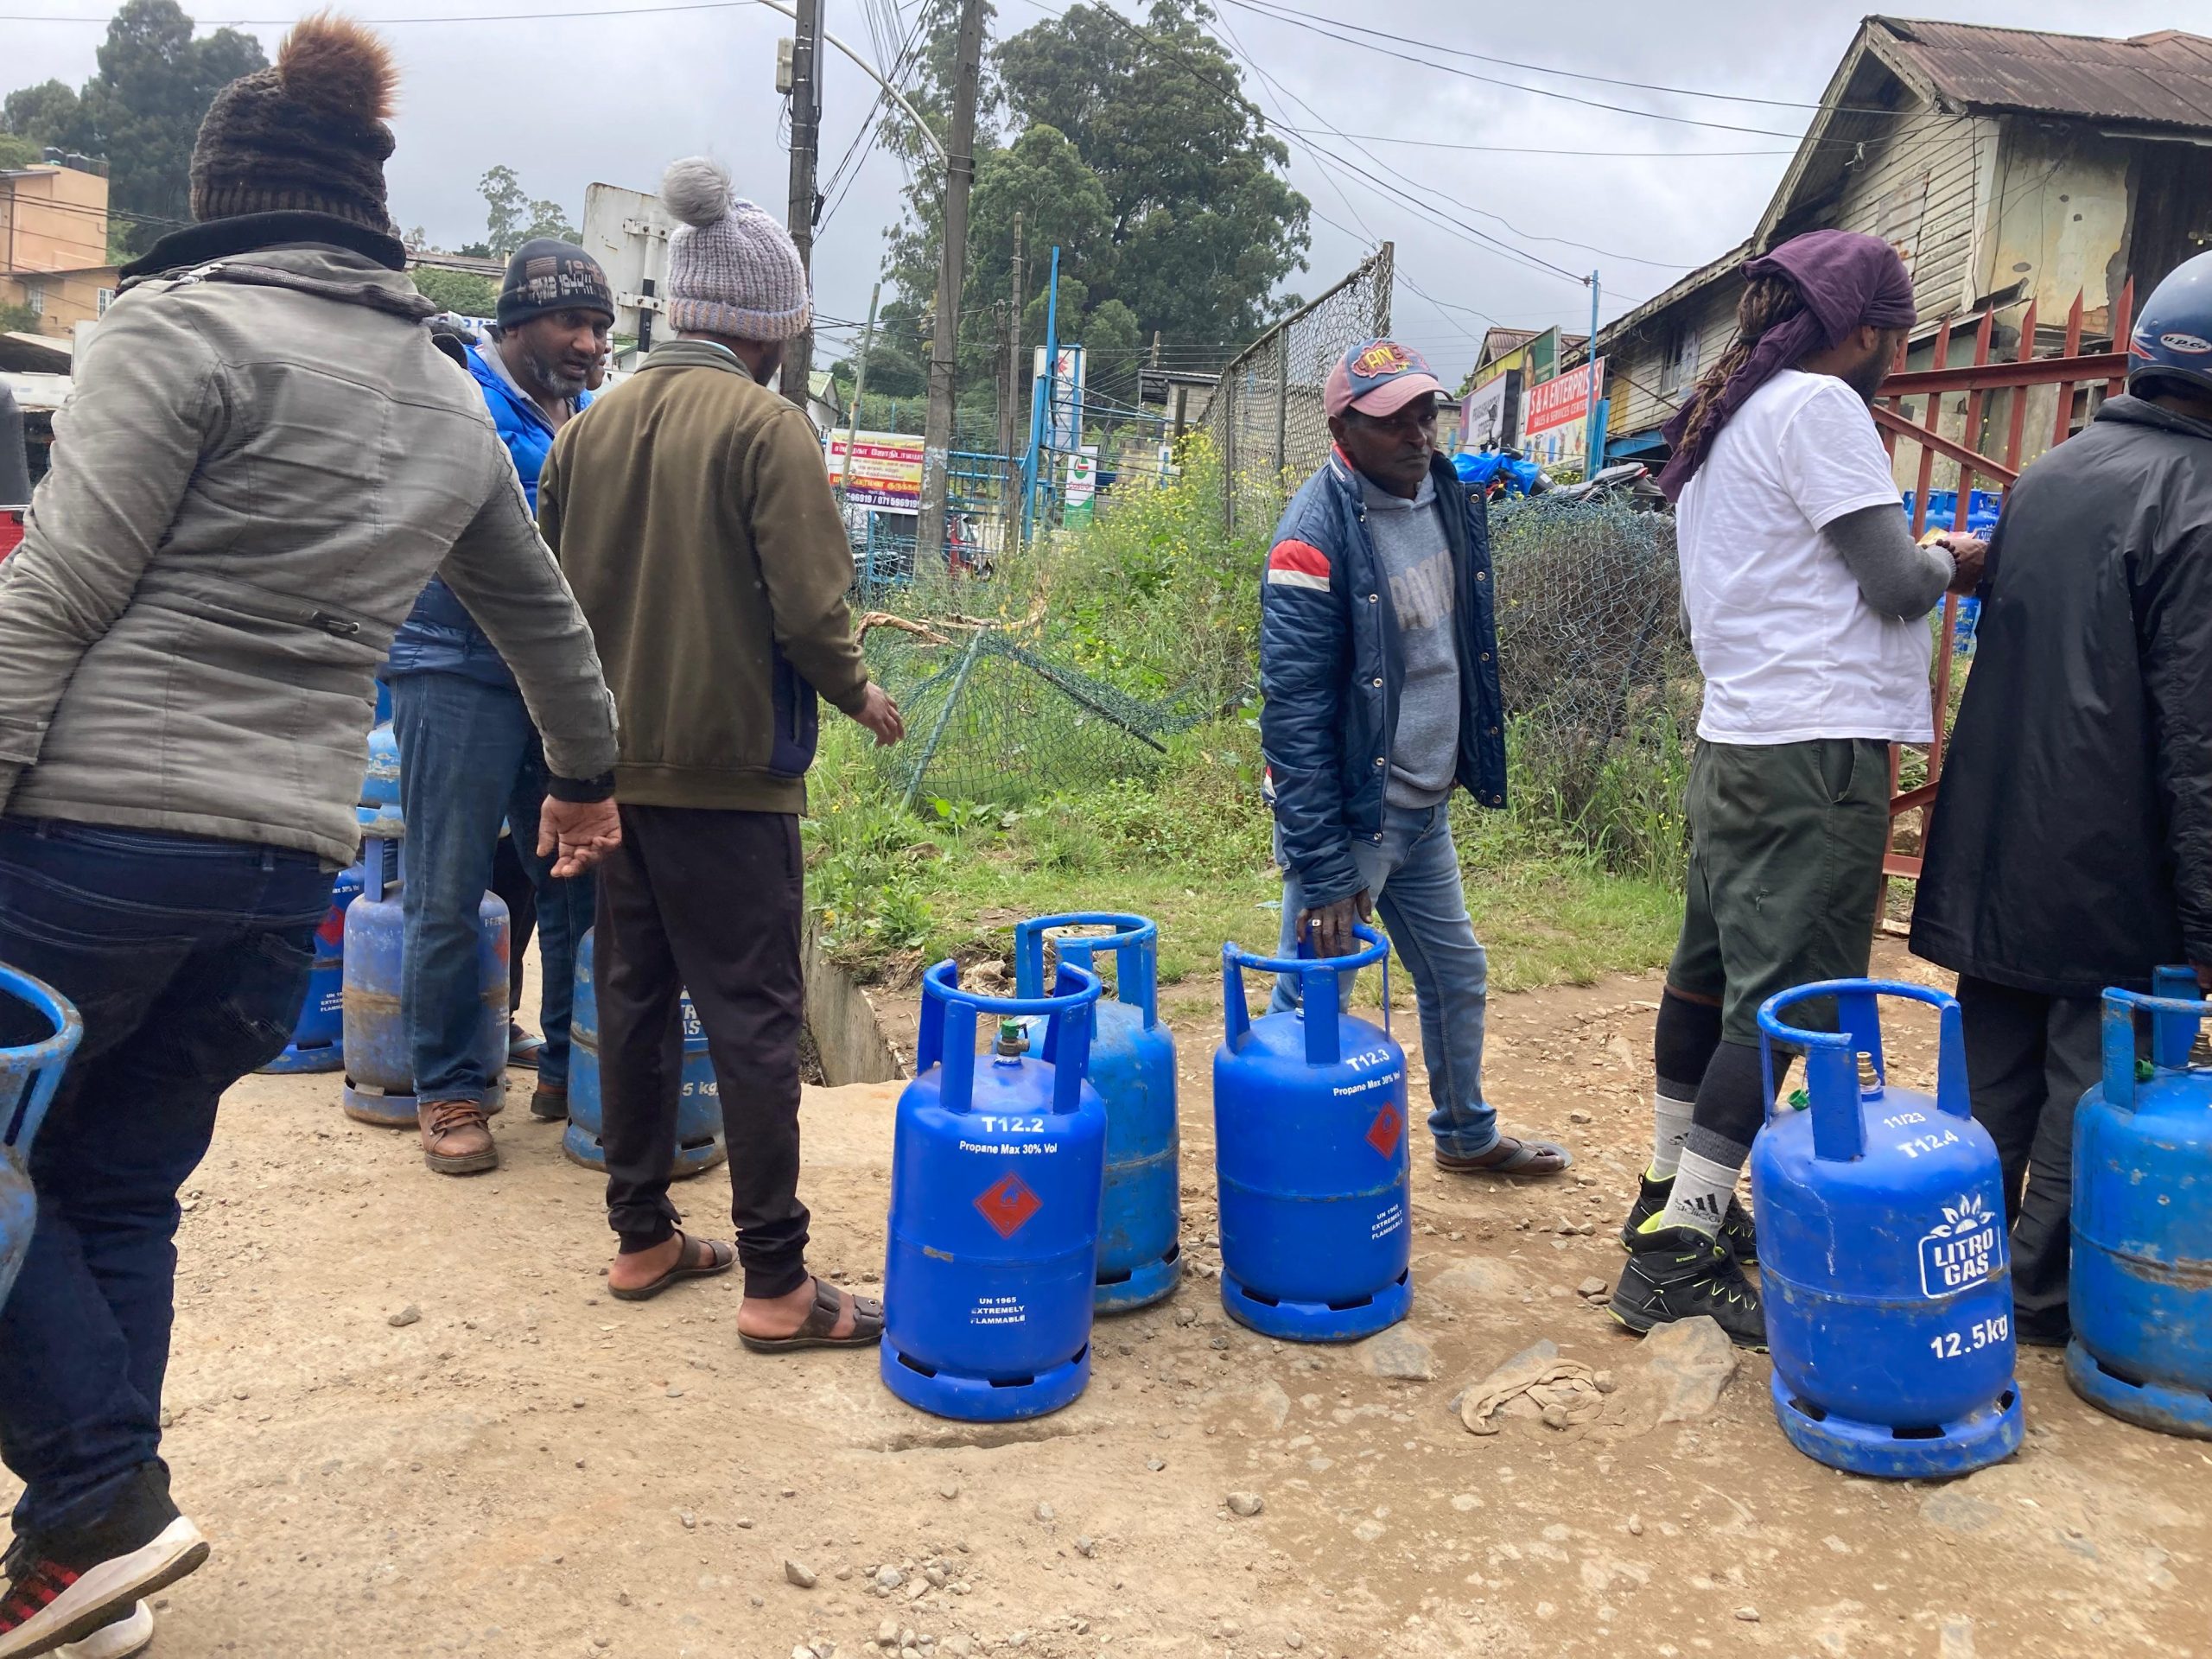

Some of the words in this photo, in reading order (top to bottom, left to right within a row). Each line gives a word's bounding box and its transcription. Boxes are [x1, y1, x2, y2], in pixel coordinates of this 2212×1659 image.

[1530, 391, 1536, 416] S
[1535, 388, 1542, 414] &
[1542, 385, 1548, 411] A
[1548, 362, 1601, 409] ENTERPRISS
[1345, 1048, 1390, 1071] T12.3
[1333, 1084, 1366, 1096] Propane
[1366, 1079, 1381, 1090] Max
[1382, 1074, 1394, 1085] 30%
[981, 1116, 1045, 1133] T12.2
[1884, 1112, 1926, 1128] 11/23
[959, 1141, 999, 1154] Propane
[1001, 1144, 1020, 1154] Max
[1022, 1144, 1042, 1154] 30%
[1044, 1143, 1058, 1153] Vol
[1895, 1129, 1959, 1158] T12.4
[1371, 1210, 1402, 1231] EXTREMELY
[1376, 1211, 1386, 1220] UN
[1371, 1217, 1403, 1240] FLAMMABLE
[1934, 1228, 1994, 1268] LITRO
[1944, 1252, 1989, 1286] GAS
[971, 1305, 1025, 1314] EXTREMELY
[1930, 1313, 2009, 1359] 12.5kg
